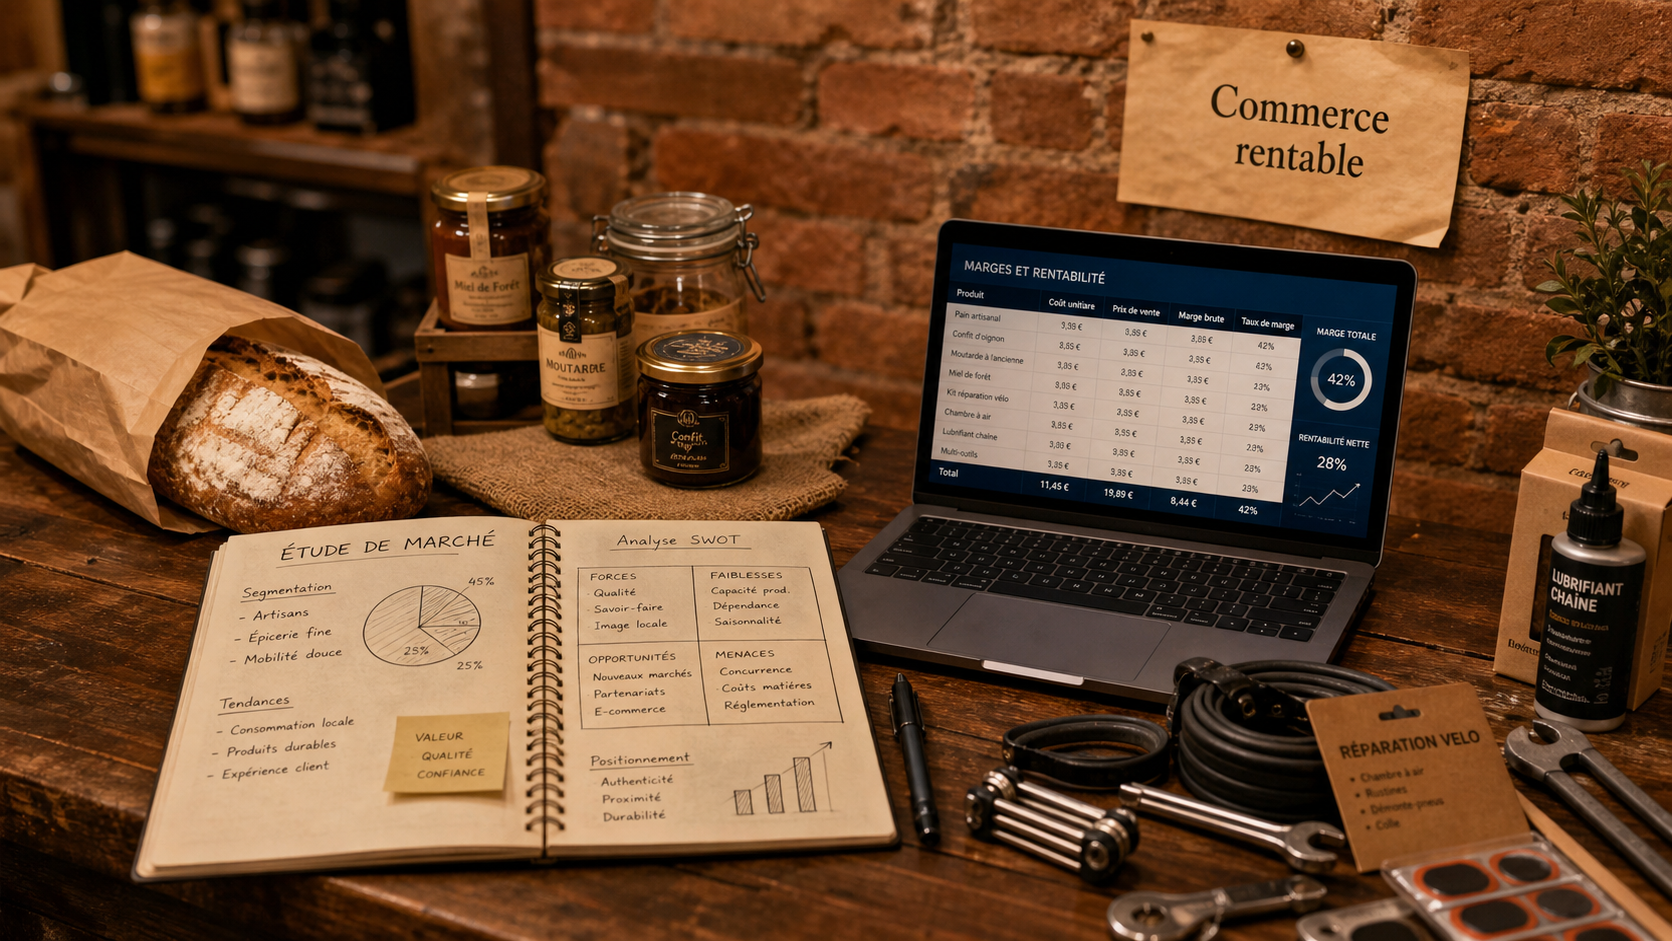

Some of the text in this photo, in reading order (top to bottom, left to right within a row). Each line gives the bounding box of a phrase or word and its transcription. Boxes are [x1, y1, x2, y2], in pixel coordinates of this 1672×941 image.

[1211, 84, 1389, 134] Commerce
[1235, 141, 1363, 178] rentable
[965, 261, 1105, 284] MARGES ET RENTABILITÉ
[455, 281, 474, 292] Miel
[478, 283, 489, 292] de
[957, 289, 984, 298] Produit
[1113, 305, 1126, 313] Prix
[955, 310, 1000, 322] Pain artisanal
[1179, 311, 1224, 323] Marge brute
[1242, 317, 1294, 331] Taux de marge
[953, 330, 973, 339] Confit
[1317, 328, 1376, 341] MARGE TOTALE
[1258, 342, 1274, 350] 42%
[951, 350, 983, 360] Moutarde
[949, 369, 963, 377] Miel
[1328, 373, 1355, 386] 42%
[958, 390, 992, 403] réparation
[995, 394, 1009, 402] vélo
[945, 408, 975, 418] Chambre
[1299, 434, 1369, 448] RENTABILITÉ NETTE
[1317, 456, 1346, 471] 28%
[939, 467, 958, 477] Total
[1064, 483, 1069, 491] €
[1128, 491, 1133, 499] €
[1171, 497, 1197, 507] 8,44 €
[1239, 506, 1257, 515] 42%
[281, 530, 495, 560] ÉTUDE DE MARCHÉ
[617, 535, 740, 551] Analyse SWOT
[469, 577, 494, 585] 45%
[1551, 568, 1624, 597] LUBRIFIANT
[241, 583, 332, 600] Segmentation
[594, 588, 636, 597] Qualité
[711, 586, 790, 596] Capacité prod.
[595, 603, 663, 613] Savoir-faire
[713, 601, 779, 612] Dépendance
[253, 610, 308, 621] Artisans
[715, 616, 781, 626] Saisonnalité
[595, 619, 667, 632] Image locale
[249, 627, 331, 645] Épicerie fine
[244, 649, 342, 664] Mobilité douce
[589, 651, 675, 664] OPPORTUNITÉS
[716, 650, 774, 658] MENACES
[457, 661, 482, 670] 25%
[720, 667, 792, 675] Concurrence
[593, 669, 692, 681] Nouveaux marchés
[595, 688, 665, 698] Partenariats
[220, 695, 291, 710] Tendances
[725, 699, 815, 712] Réglementation
[595, 707, 665, 716] E-commerce
[231, 716, 354, 735] Consommation locale
[416, 732, 463, 742] VALEUR
[227, 739, 336, 757] Produits durables
[1339, 730, 1480, 759] RÉPARATION VELO
[422, 748, 472, 761] QUALITÉ
[591, 752, 690, 766] Positionnement
[222, 761, 329, 781] Expérience client
[418, 769, 484, 779] CONFIANCE
[1360, 768, 1423, 782] Chambre à air
[601, 774, 673, 786] Authenticité
[1365, 784, 1407, 798] Rustines
[603, 792, 661, 803] Proximité
[1370, 798, 1445, 815] Démonte-pneus
[604, 810, 665, 822] Durabilité
[1376, 818, 1400, 830] Colle
